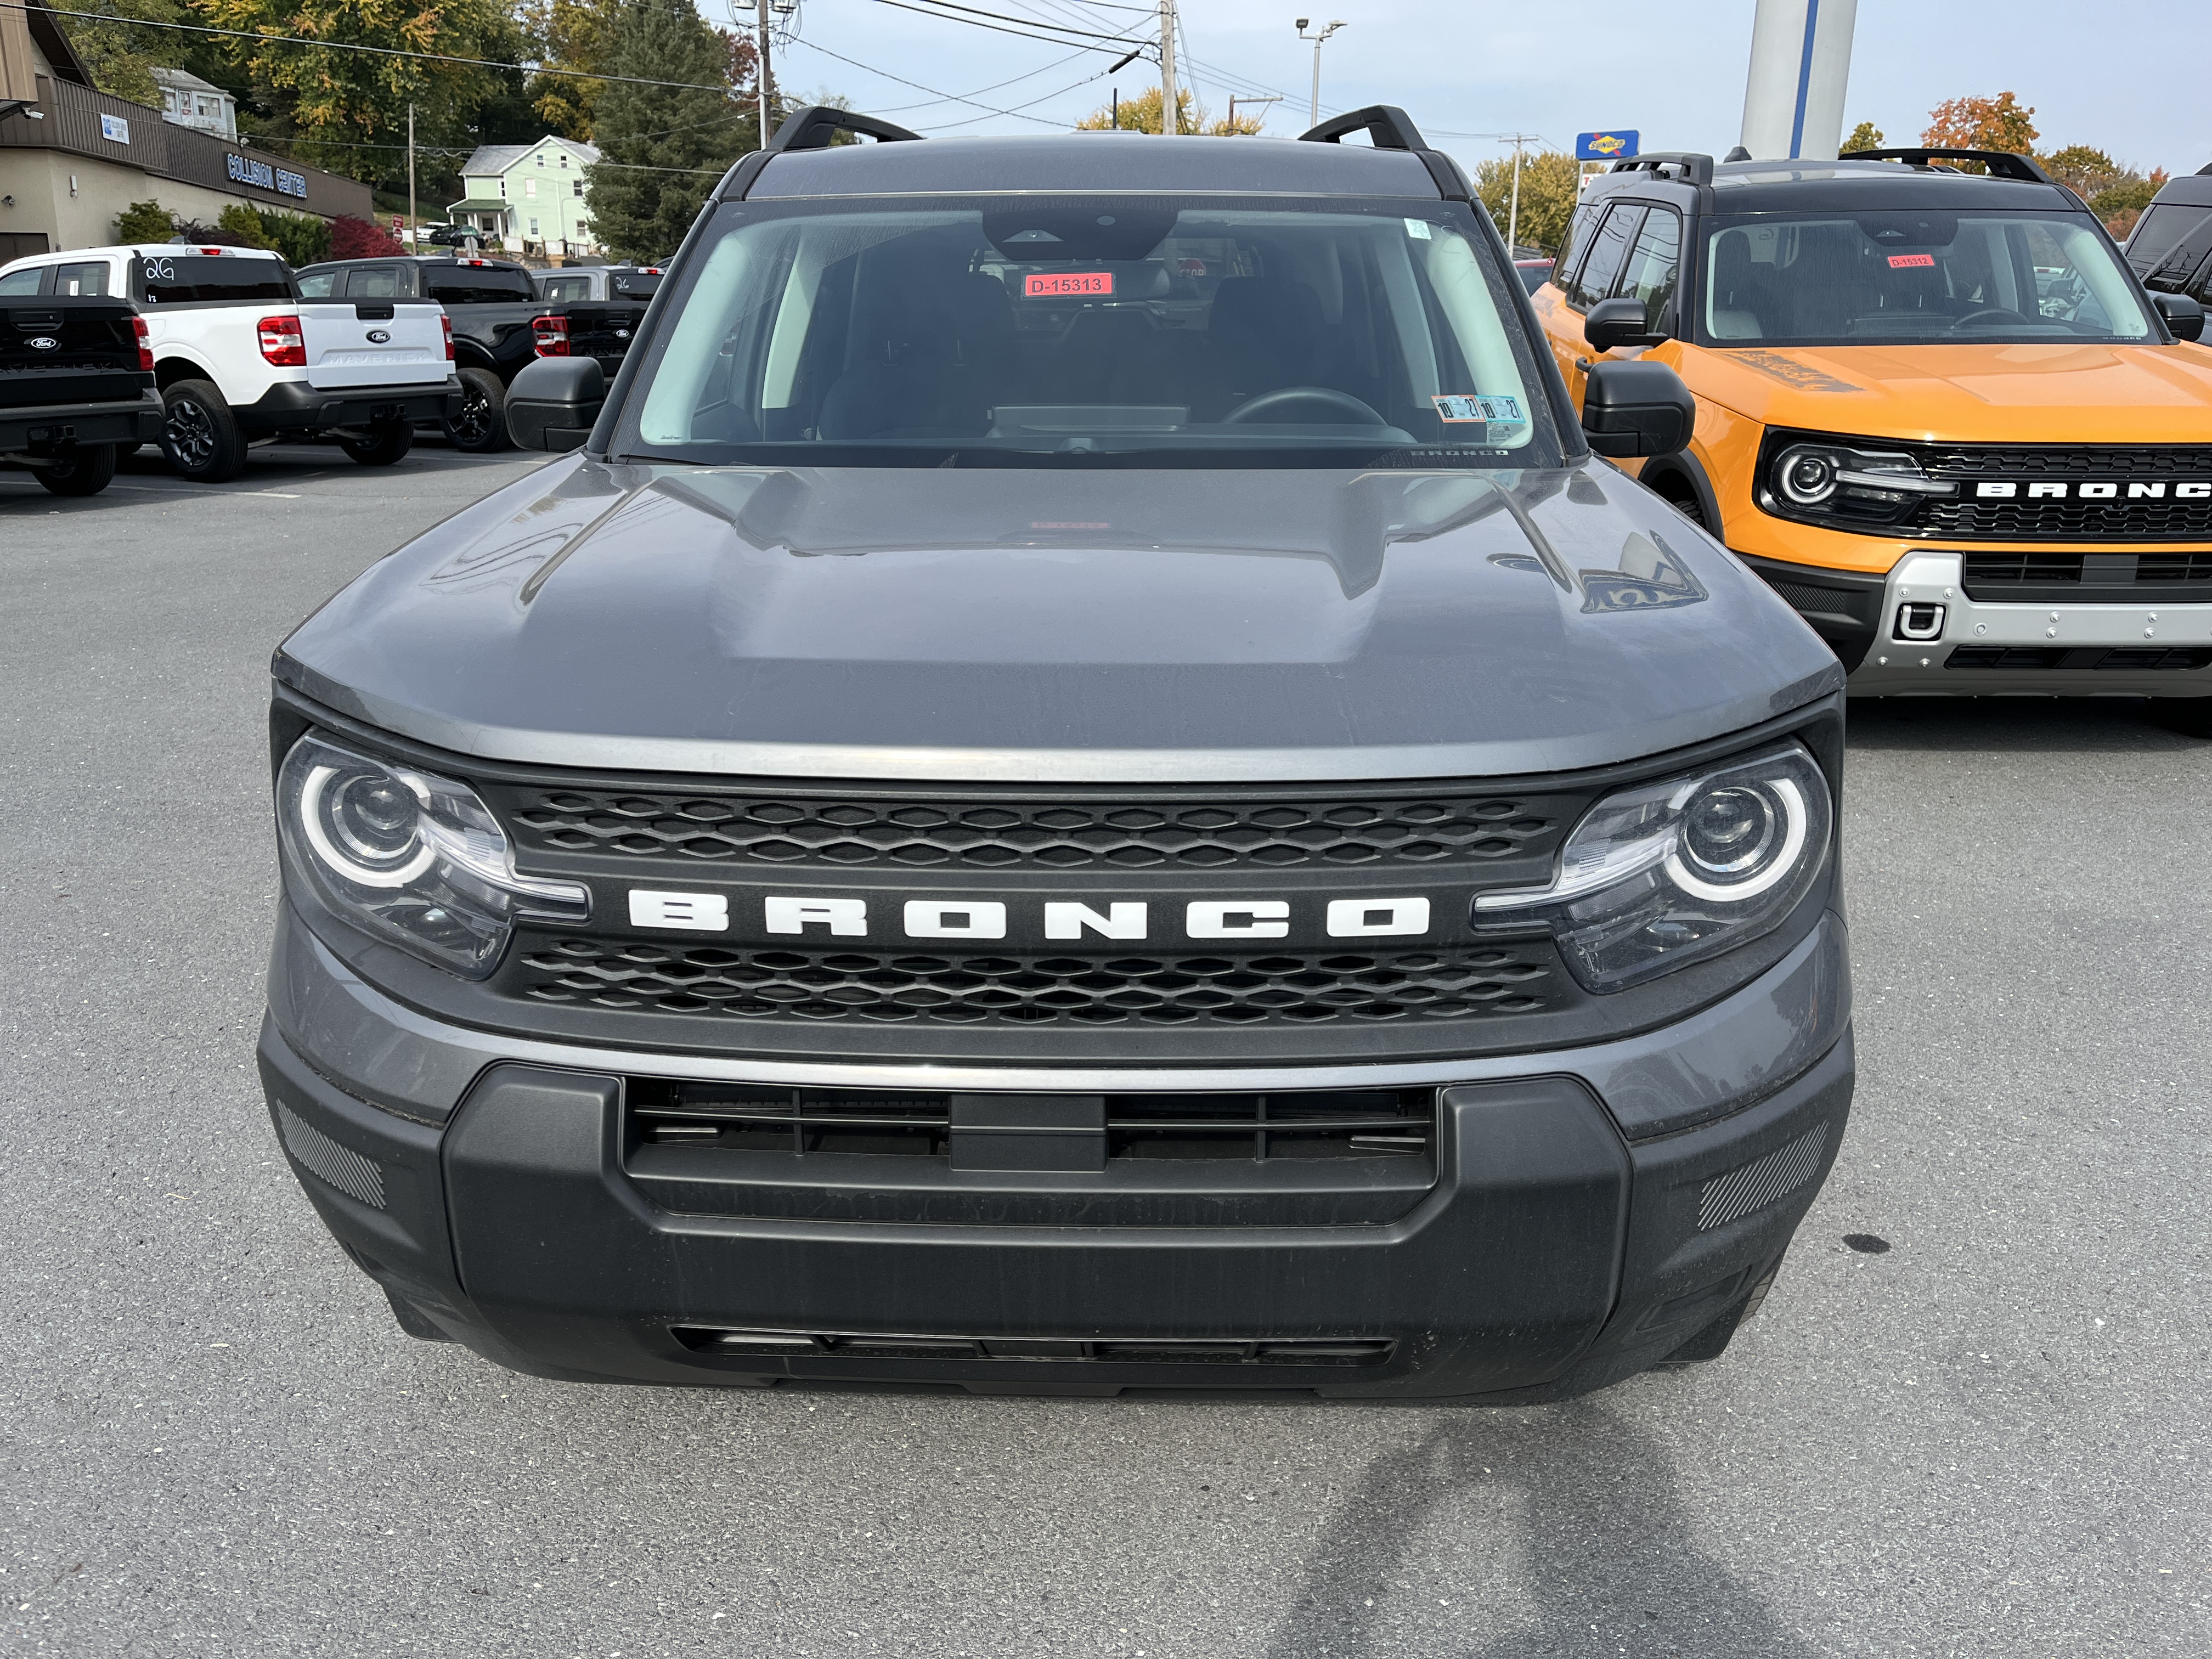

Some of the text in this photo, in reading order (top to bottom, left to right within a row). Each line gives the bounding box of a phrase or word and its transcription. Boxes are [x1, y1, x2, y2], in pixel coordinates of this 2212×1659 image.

[228, 153, 308, 199] COLLISION CENTER
[1892, 257, 1929, 267] D-15312
[1032, 278, 1102, 293] D-15313
[1464, 399, 1480, 419] 27
[1506, 400, 1521, 420] 27
[1977, 483, 2211, 498] BRONC
[628, 889, 1431, 939] BRONCO
